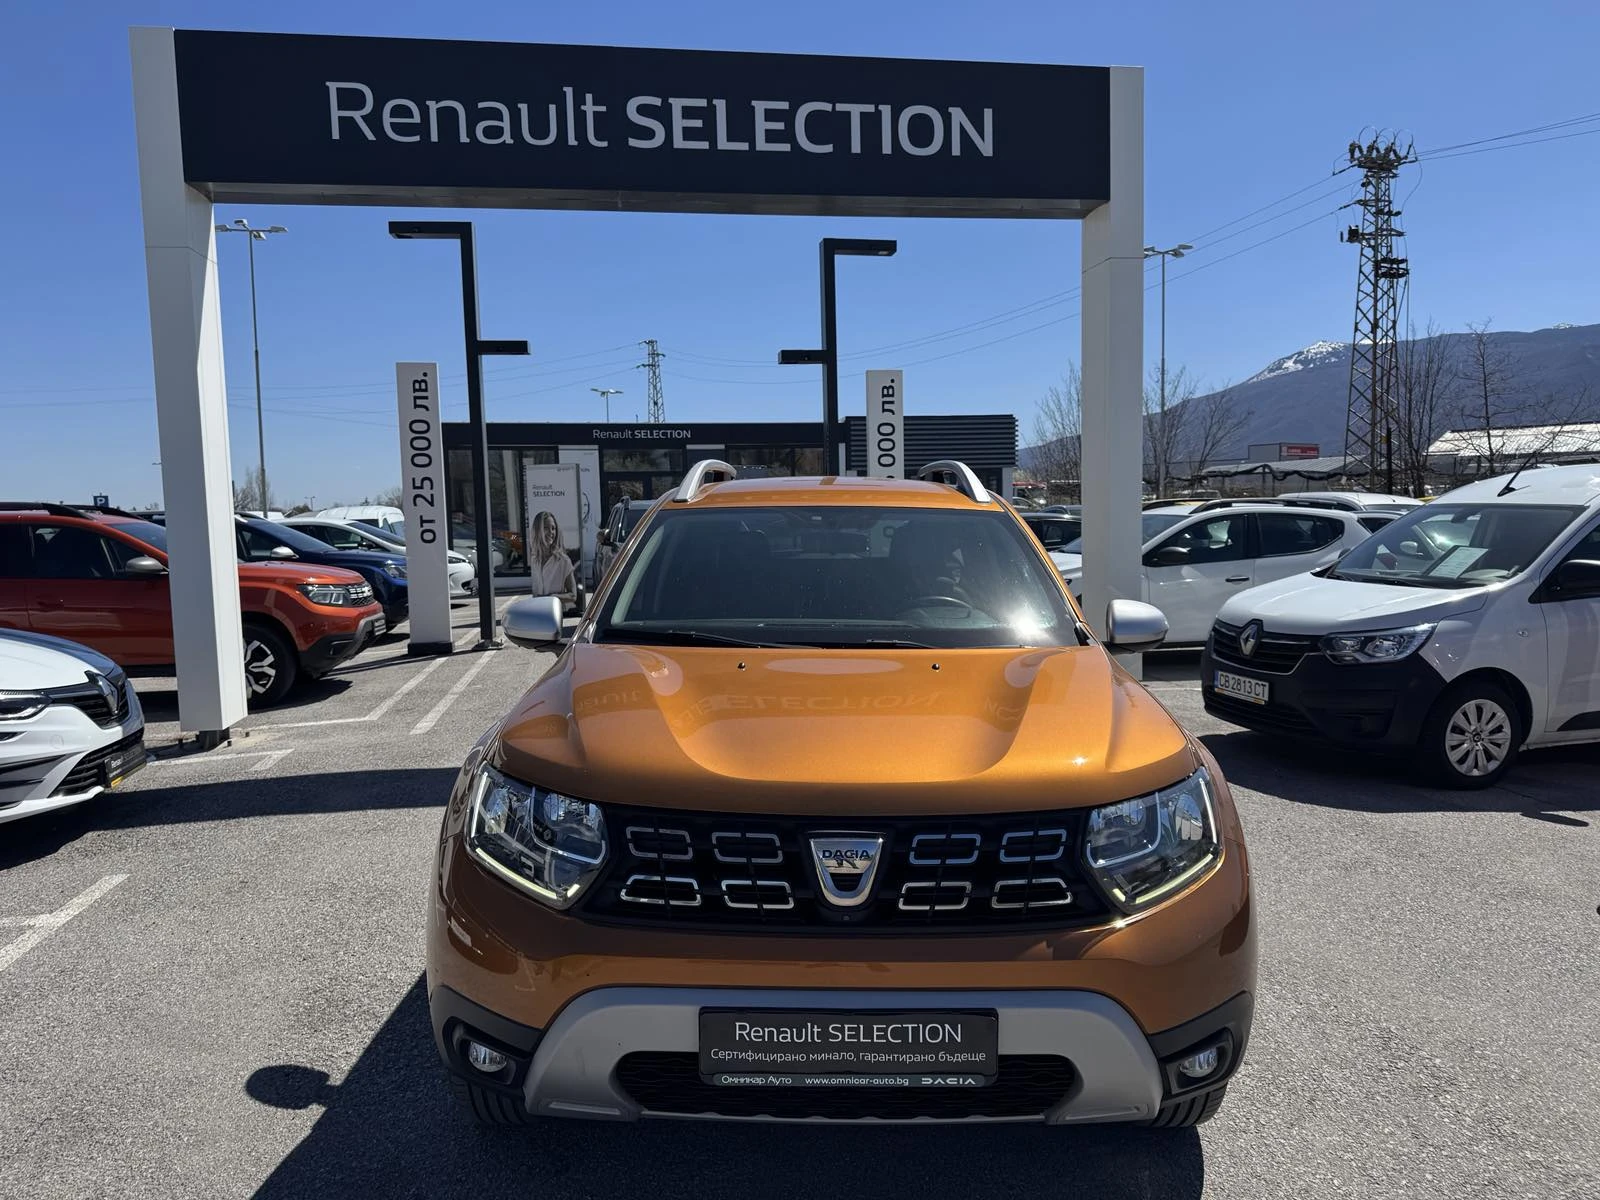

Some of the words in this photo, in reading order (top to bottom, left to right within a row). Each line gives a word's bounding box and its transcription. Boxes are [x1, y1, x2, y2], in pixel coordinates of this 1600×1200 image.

[325, 80, 609, 148] Renault
[627, 95, 995, 158] SELECTION
[412, 371, 429, 412] лв.
[881, 378, 896, 416] лв.
[408, 419, 433, 469] 000
[592, 429, 632, 439] Renault
[634, 429, 692, 439] SELECTION
[877, 422, 896, 468] 000
[412, 476, 434, 508] 25
[420, 515, 437, 544] от
[1231, 676, 1253, 694] 2813
[822, 849, 871, 859] DACIA
[735, 1021, 822, 1044] Renault
[828, 1022, 963, 1044] SELECTION
[710, 1048, 807, 1063] Сертифицирано
[809, 1051, 857, 1062] минало,
[859, 1052, 936, 1064] гарантирано
[938, 1051, 987, 1063] бъдеще
[721, 1075, 766, 1086] Омникар
[767, 1075, 792, 1086] Ауто
[805, 1076, 910, 1087] www.omnicar-auto.bg
[921, 1077, 977, 1085] DACIA
